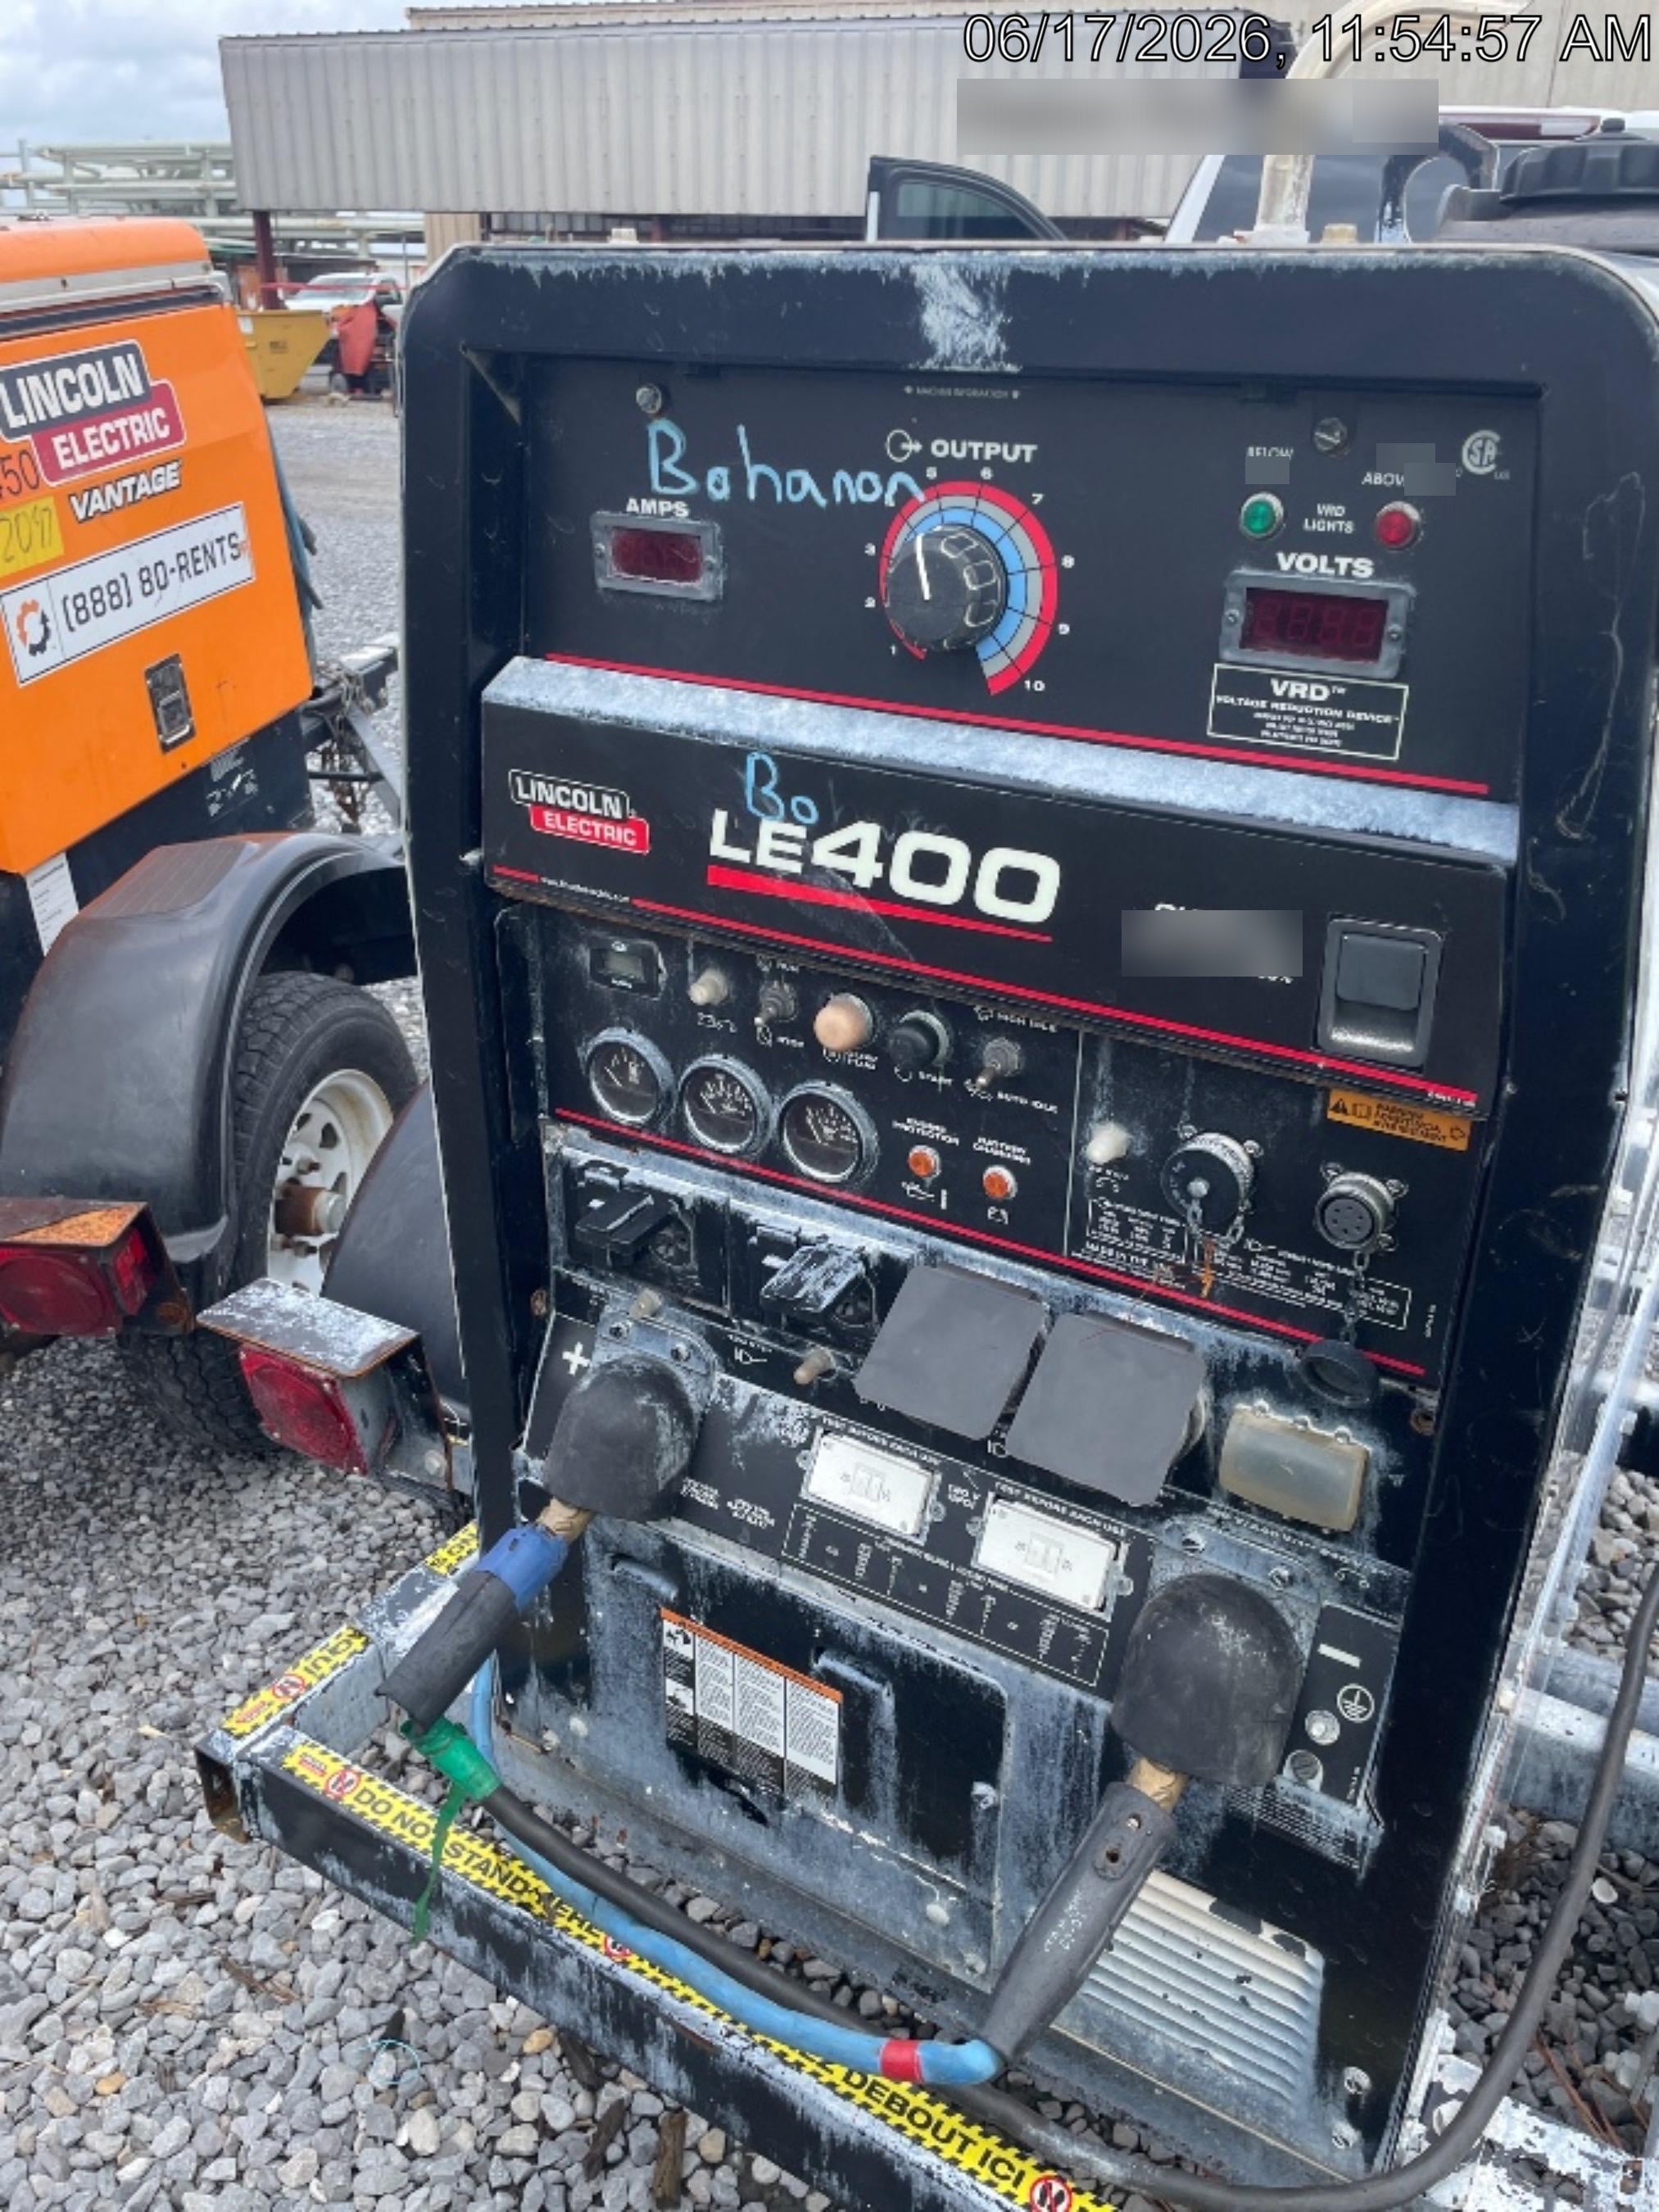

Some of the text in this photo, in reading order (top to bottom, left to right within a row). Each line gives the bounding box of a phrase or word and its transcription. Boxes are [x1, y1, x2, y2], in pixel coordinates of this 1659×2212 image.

[0, 353, 145, 428] LINCOLN
[52, 407, 170, 469] ELECTRIC
[931, 439, 1038, 463] OUTPUT
[981, 468, 993, 480] 6
[1362, 472, 1405, 487] ABOV
[69, 459, 183, 524] VANTAGE
[1032, 493, 1044, 505] 7
[626, 497, 691, 518] AMPS
[1303, 519, 1355, 534] LIGHTS
[1276, 551, 1375, 578] VOLTS
[62, 532, 243, 632] (888) 80-RENTS
[890, 644, 898, 655] 1
[1024, 679, 1045, 693] 10
[515, 775, 623, 819] LINCOLN
[543, 810, 637, 846] ELECTRIC
[709, 808, 1061, 923] LE400
[353, 1787, 393, 1815] DO
[392, 1809, 432, 1840] NO
[444, 1841, 530, 1894] STAND
[842, 2068, 1027, 2189] DEBOUT ICI
